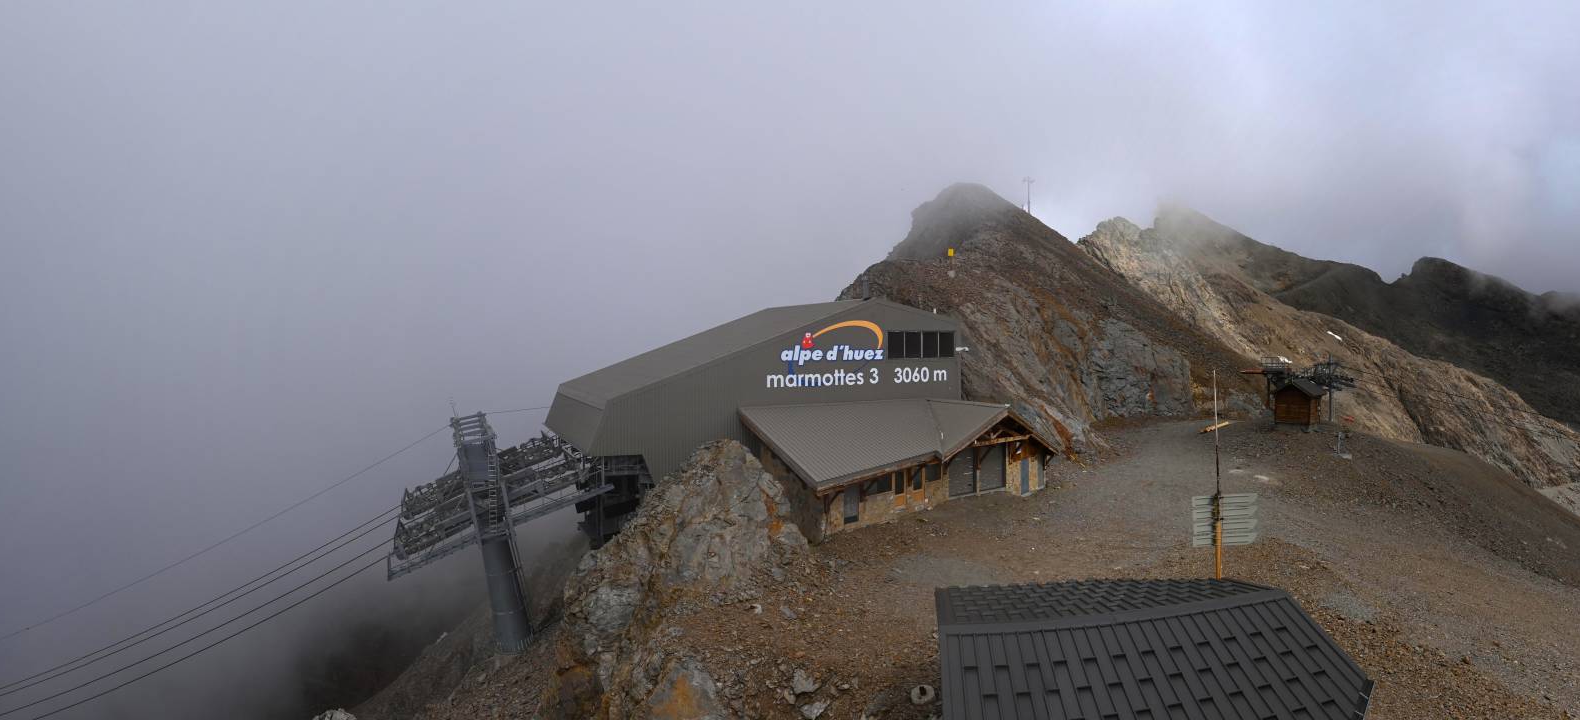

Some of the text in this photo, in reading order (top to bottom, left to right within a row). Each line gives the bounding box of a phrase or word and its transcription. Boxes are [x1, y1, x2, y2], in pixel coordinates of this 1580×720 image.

[781, 345, 884, 365] alpe d'huez
[766, 367, 947, 388] marmottes 3 3060 m
